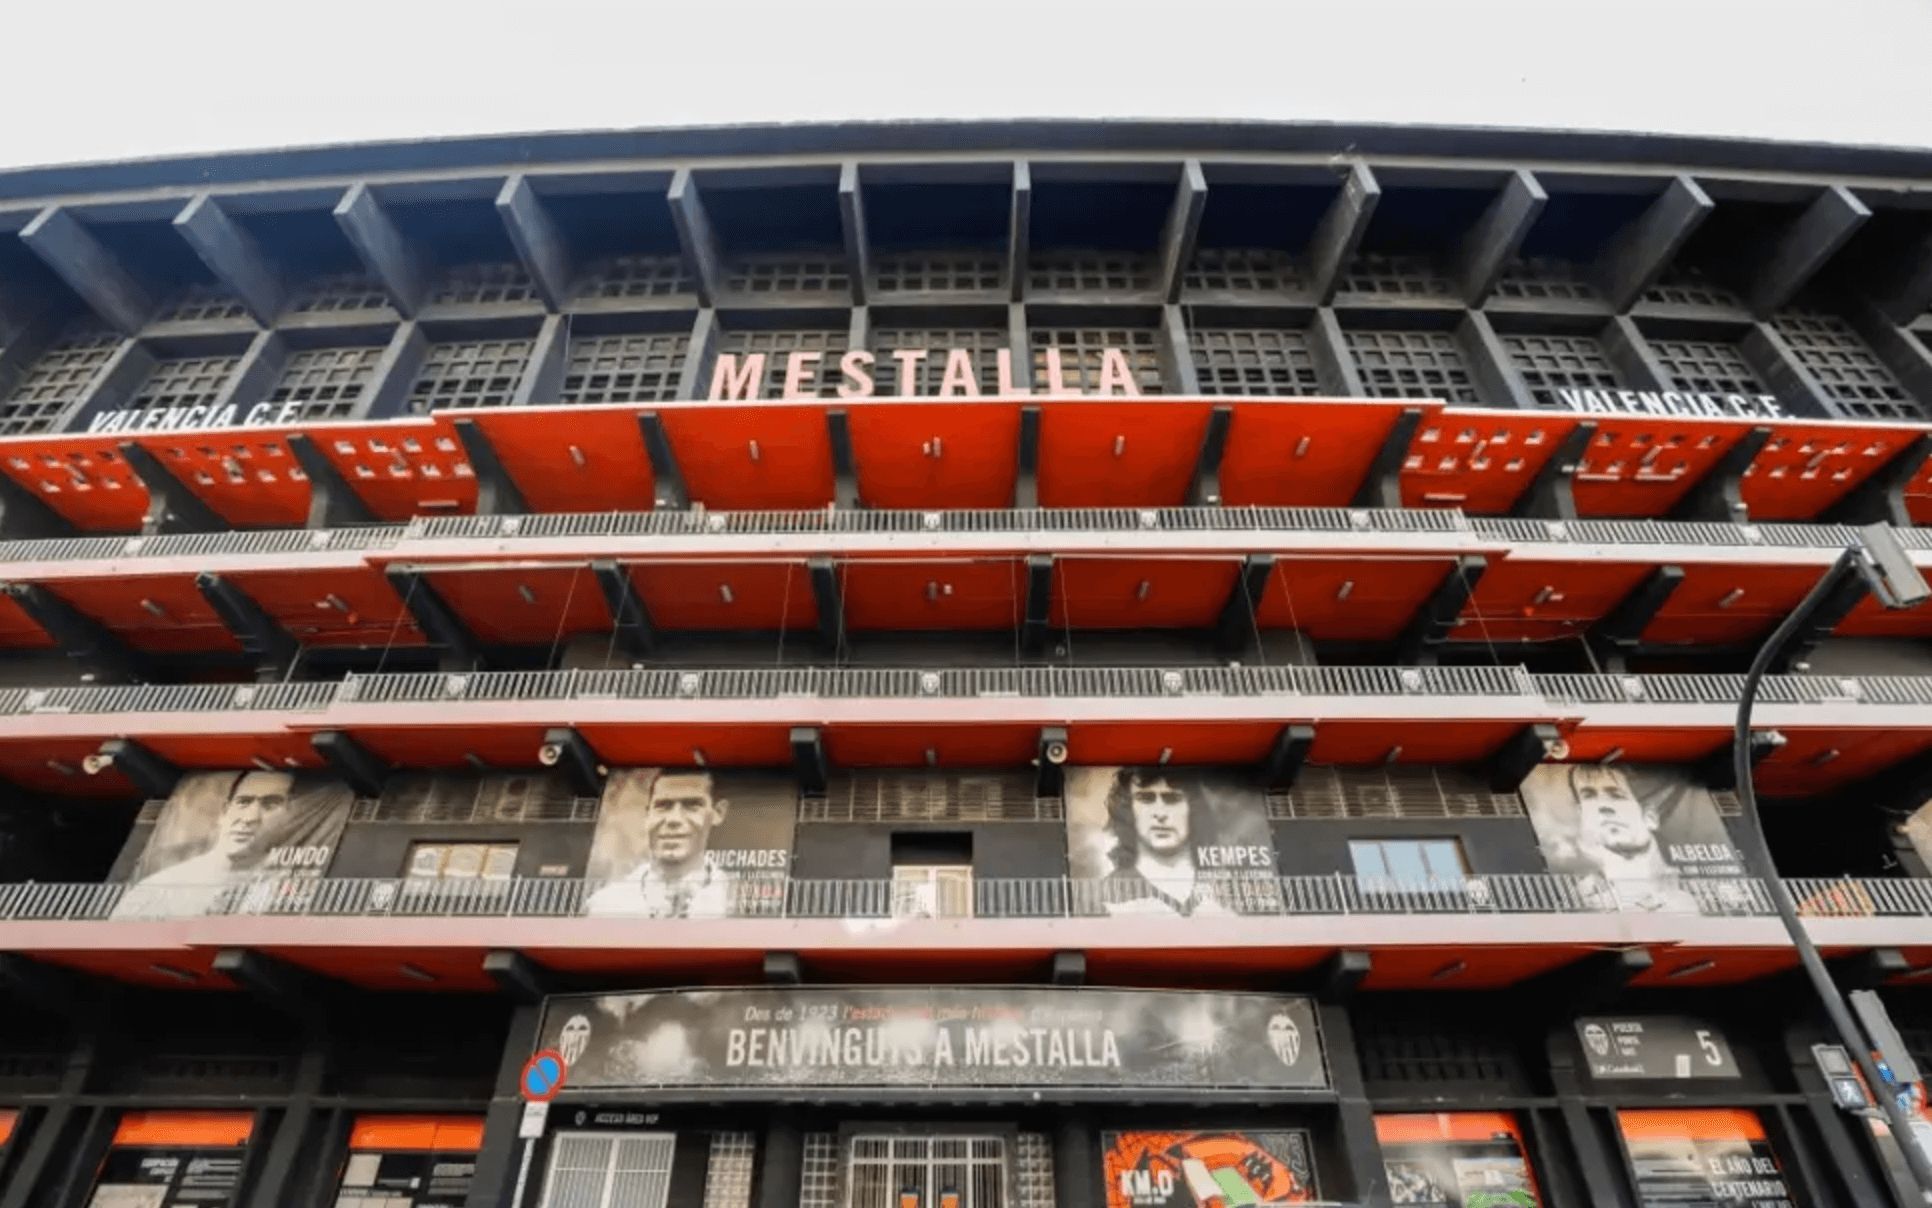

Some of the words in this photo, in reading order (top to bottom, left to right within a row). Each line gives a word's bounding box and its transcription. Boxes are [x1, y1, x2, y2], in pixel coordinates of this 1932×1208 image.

[708, 347, 1141, 400] MESTALLA
[1559, 389, 1724, 417] VALENCIA
[87, 403, 239, 434] VALENCIA
[265, 846, 329, 866] MUNDO
[1197, 845, 1272, 866] KEMPES
[745, 1006, 771, 1022] Des
[775, 1006, 793, 1022] de
[800, 1005, 839, 1022] 1923
[934, 1027, 954, 1067] A
[965, 1027, 1121, 1067] MESTALLA
[1695, 1030, 1723, 1066] 5
[1708, 1158, 1727, 1174] EL
[1727, 1155, 1753, 1174] AÑO
[1751, 1157, 1778, 1174] DEL
[1711, 1180, 1788, 1199] CENTENARIO
